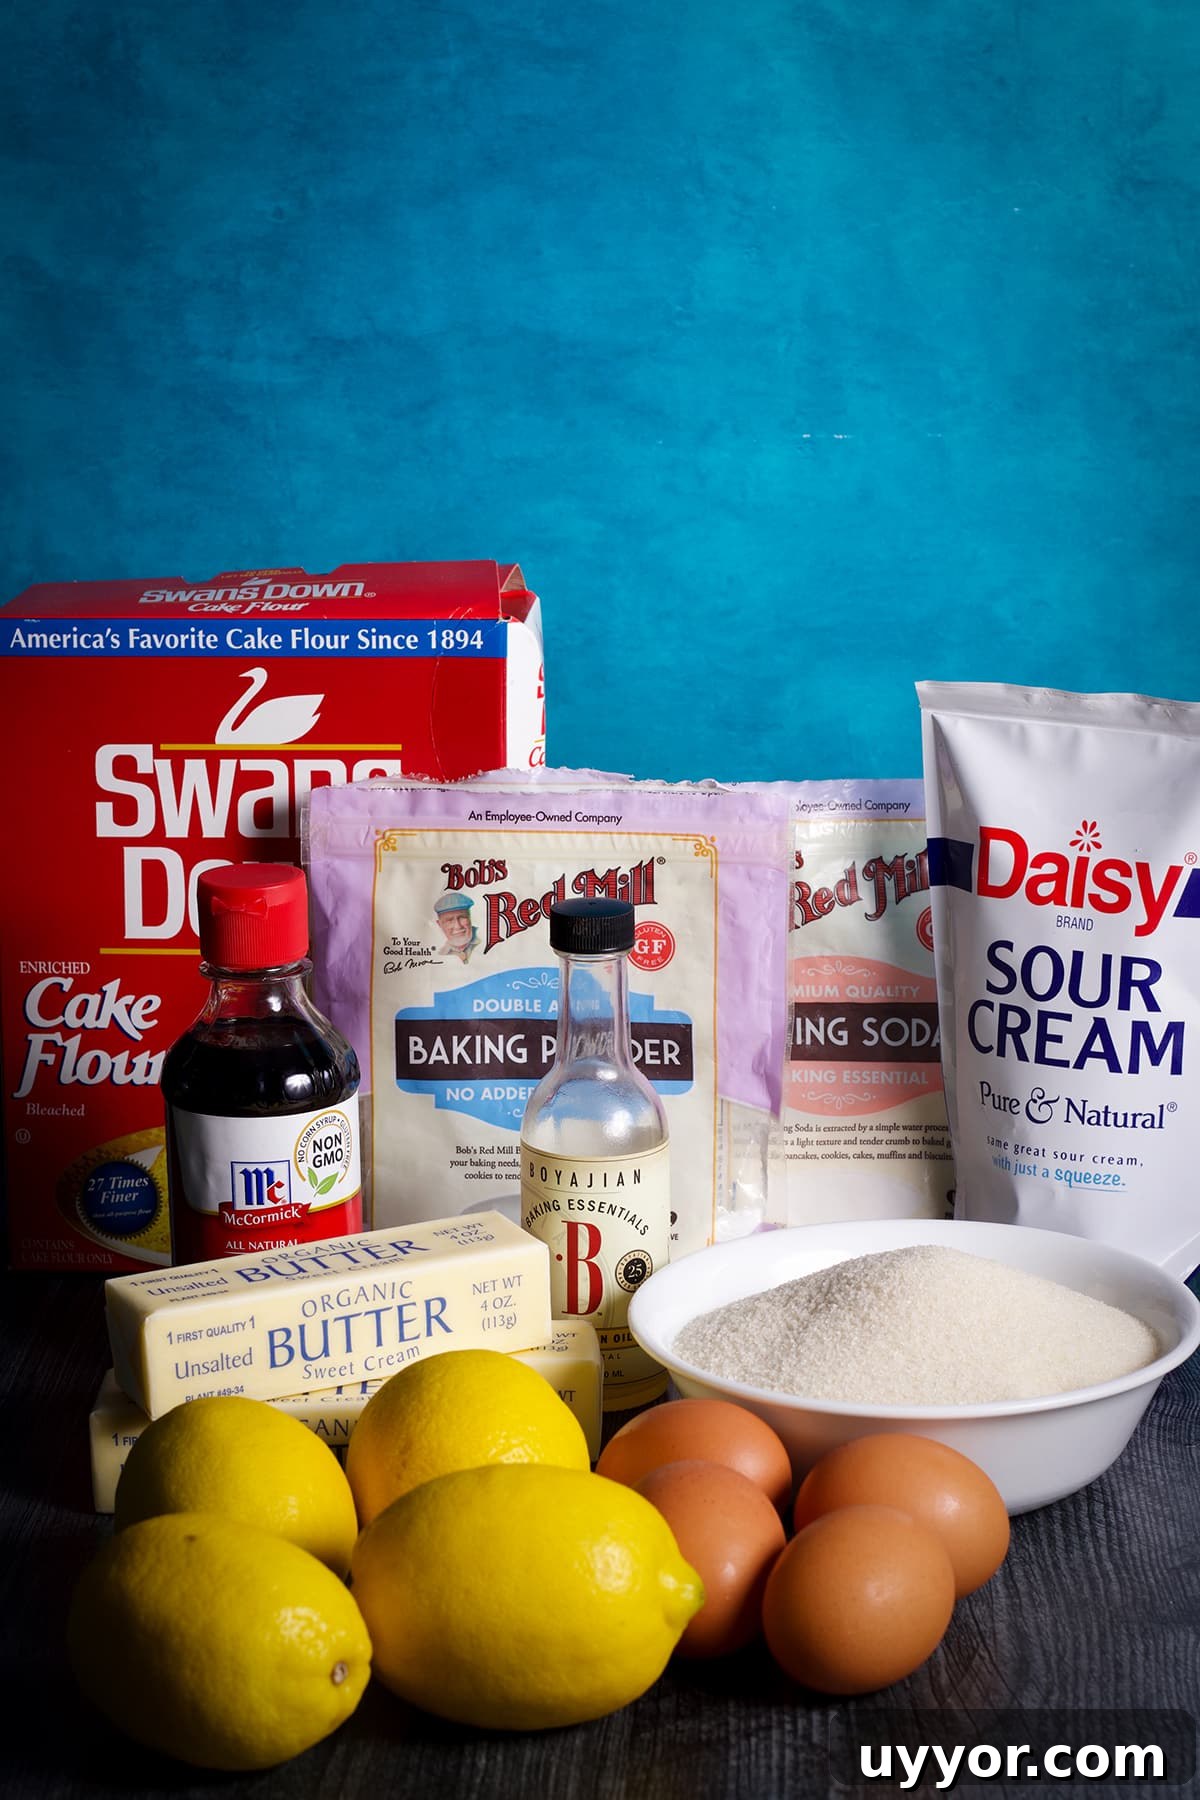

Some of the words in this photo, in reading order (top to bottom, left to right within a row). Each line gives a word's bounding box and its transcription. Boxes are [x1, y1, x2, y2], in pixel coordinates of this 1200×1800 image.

[187, 602, 242, 614] Cake
[241, 601, 309, 615] Flour
[10, 627, 120, 649] America's
[128, 628, 218, 649] Favorite
[226, 627, 283, 649] Cake
[290, 627, 350, 649] Flour
[357, 627, 419, 650] Since
[427, 629, 484, 650] 1894
[864, 800, 911, 813] Company
[468, 811, 483, 821] An
[485, 810, 572, 824] Employee-Owned
[574, 812, 623, 825] Company
[440, 858, 509, 891] Bob's
[789, 861, 863, 932] Red
[483, 873, 566, 955] Red
[1056, 914, 1094, 931] BRAND
[391, 937, 401, 946] To
[403, 937, 421, 947] Your
[634, 939, 666, 954] GF
[383, 947, 403, 956] Good
[20, 961, 91, 974] ENRICHED
[636, 956, 665, 966] FREE
[985, 939, 1163, 1013] SOUR
[845, 985, 920, 998] QUALITY
[24, 977, 162, 1042] Cake
[473, 1000, 541, 1012] DOUBLE
[968, 999, 1186, 1077] CREAM
[408, 1034, 528, 1065] BAKING
[542, 1035, 681, 1066] PDER
[842, 1070, 928, 1084] ESSENTIAL
[446, 1088, 474, 1101] NO
[979, 1081, 1020, 1115] Pure
[1025, 1087, 1060, 1124] &
[26, 1103, 85, 1117] Bleached
[315, 1115, 337, 1129] SYRUP
[794, 1123, 813, 1132] Soda
[815, 1124, 821, 1132] is
[823, 1123, 856, 1132] extracted
[858, 1123, 868, 1133] by
[875, 1122, 900, 1133] simple
[300, 1126, 316, 1148] CORN
[313, 1132, 343, 1153] NON
[796, 1137, 813, 1148] light
[816, 1138, 841, 1146] texture
[843, 1136, 857, 1145] and
[859, 1136, 883, 1145] tender
[885, 1136, 910, 1145] crumb
[912, 1137, 920, 1145] to
[922, 1136, 944, 1145] baked
[298, 1150, 306, 1163] NO
[456, 1145, 477, 1155] Bob's
[479, 1145, 495, 1155] Red
[497, 1145, 513, 1155] Mill
[821, 1151, 851, 1160] cookies,
[852, 1150, 875, 1160] cakes,
[877, 1150, 906, 1159] muffins
[908, 1150, 922, 1159] and
[987, 1135, 1009, 1150] same
[1014, 1143, 1046, 1157] great
[1053, 1149, 1085, 1162] sour
[312, 1148, 344, 1168] GMO
[450, 1160, 468, 1168] your
[470, 1158, 496, 1169] baking
[464, 1171, 493, 1180] cookies
[529, 1162, 641, 1188] BOYAJIAN
[992, 1155, 1011, 1171] with
[1014, 1160, 1037, 1176] just
[1042, 1168, 1049, 1178] a
[1054, 1168, 1126, 1188] squeeze.
[88, 1178, 104, 1191] 27
[110, 1176, 149, 1190] Times
[101, 1190, 139, 1204] Finer
[223, 1206, 302, 1226] McCormick
[525, 1199, 561, 1228] BAKING
[568, 1199, 649, 1236] ESSENTIALS
[433, 1226, 459, 1237] NET
[462, 1222, 484, 1230] WT
[226, 1240, 246, 1250] ALL
[249, 1239, 299, 1250] NATURAL
[261, 1239, 374, 1264] ORGANIC
[234, 1239, 432, 1283] BUTTER
[628, 1265, 643, 1278] 25
[147, 1277, 229, 1296] Unsalted
[472, 1279, 498, 1296] NET
[502, 1274, 524, 1290] WT
[301, 1281, 414, 1318] ORGANIC
[480, 1300, 488, 1312] 4
[492, 1295, 517, 1310] OZ.
[166, 1331, 174, 1345] 1
[176, 1330, 203, 1344] FIRST
[206, 1322, 247, 1337] QUALITY
[249, 1315, 256, 1329] 1
[481, 1312, 518, 1332] (113g)
[267, 1296, 454, 1370] BUTTER
[175, 1347, 253, 1380] Unsalted
[302, 1362, 354, 1380] Sweet
[364, 1345, 420, 1371] Cream
